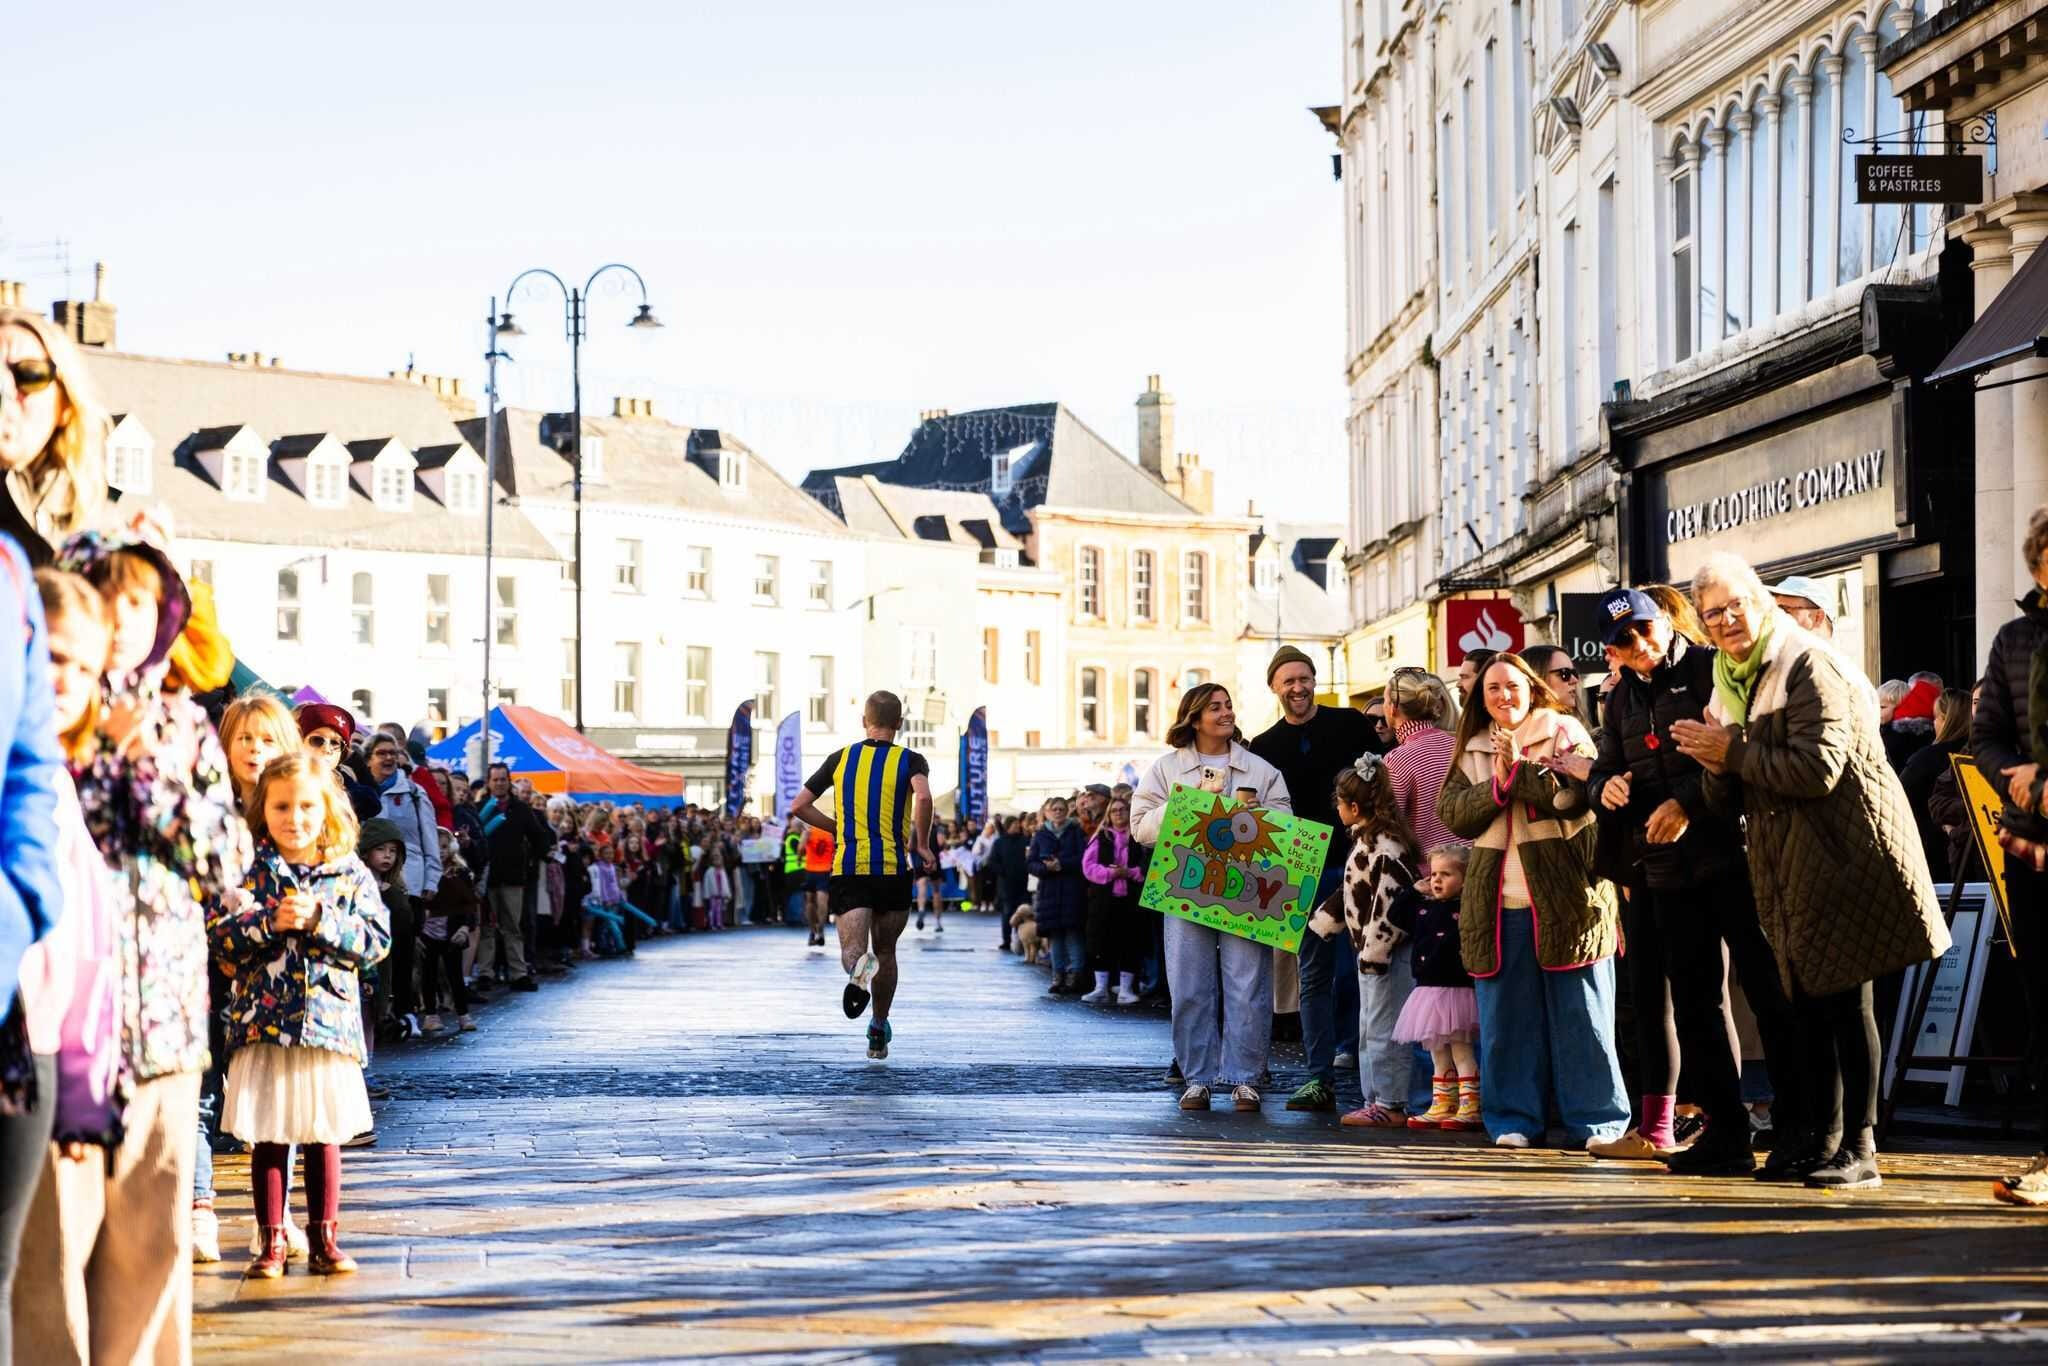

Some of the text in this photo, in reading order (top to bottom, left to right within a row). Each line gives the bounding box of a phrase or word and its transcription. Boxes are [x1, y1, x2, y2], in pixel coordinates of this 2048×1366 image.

[1868, 165, 1914, 178] COFFEE
[1868, 180, 1941, 192] & PASTRIES
[1667, 449, 1884, 544] CREW CLOTHING COMPANY
[1207, 811, 1258, 851] GO
[1288, 847, 1304, 859] the
[1302, 843, 1319, 855] are
[1294, 860, 1320, 877] BEST!
